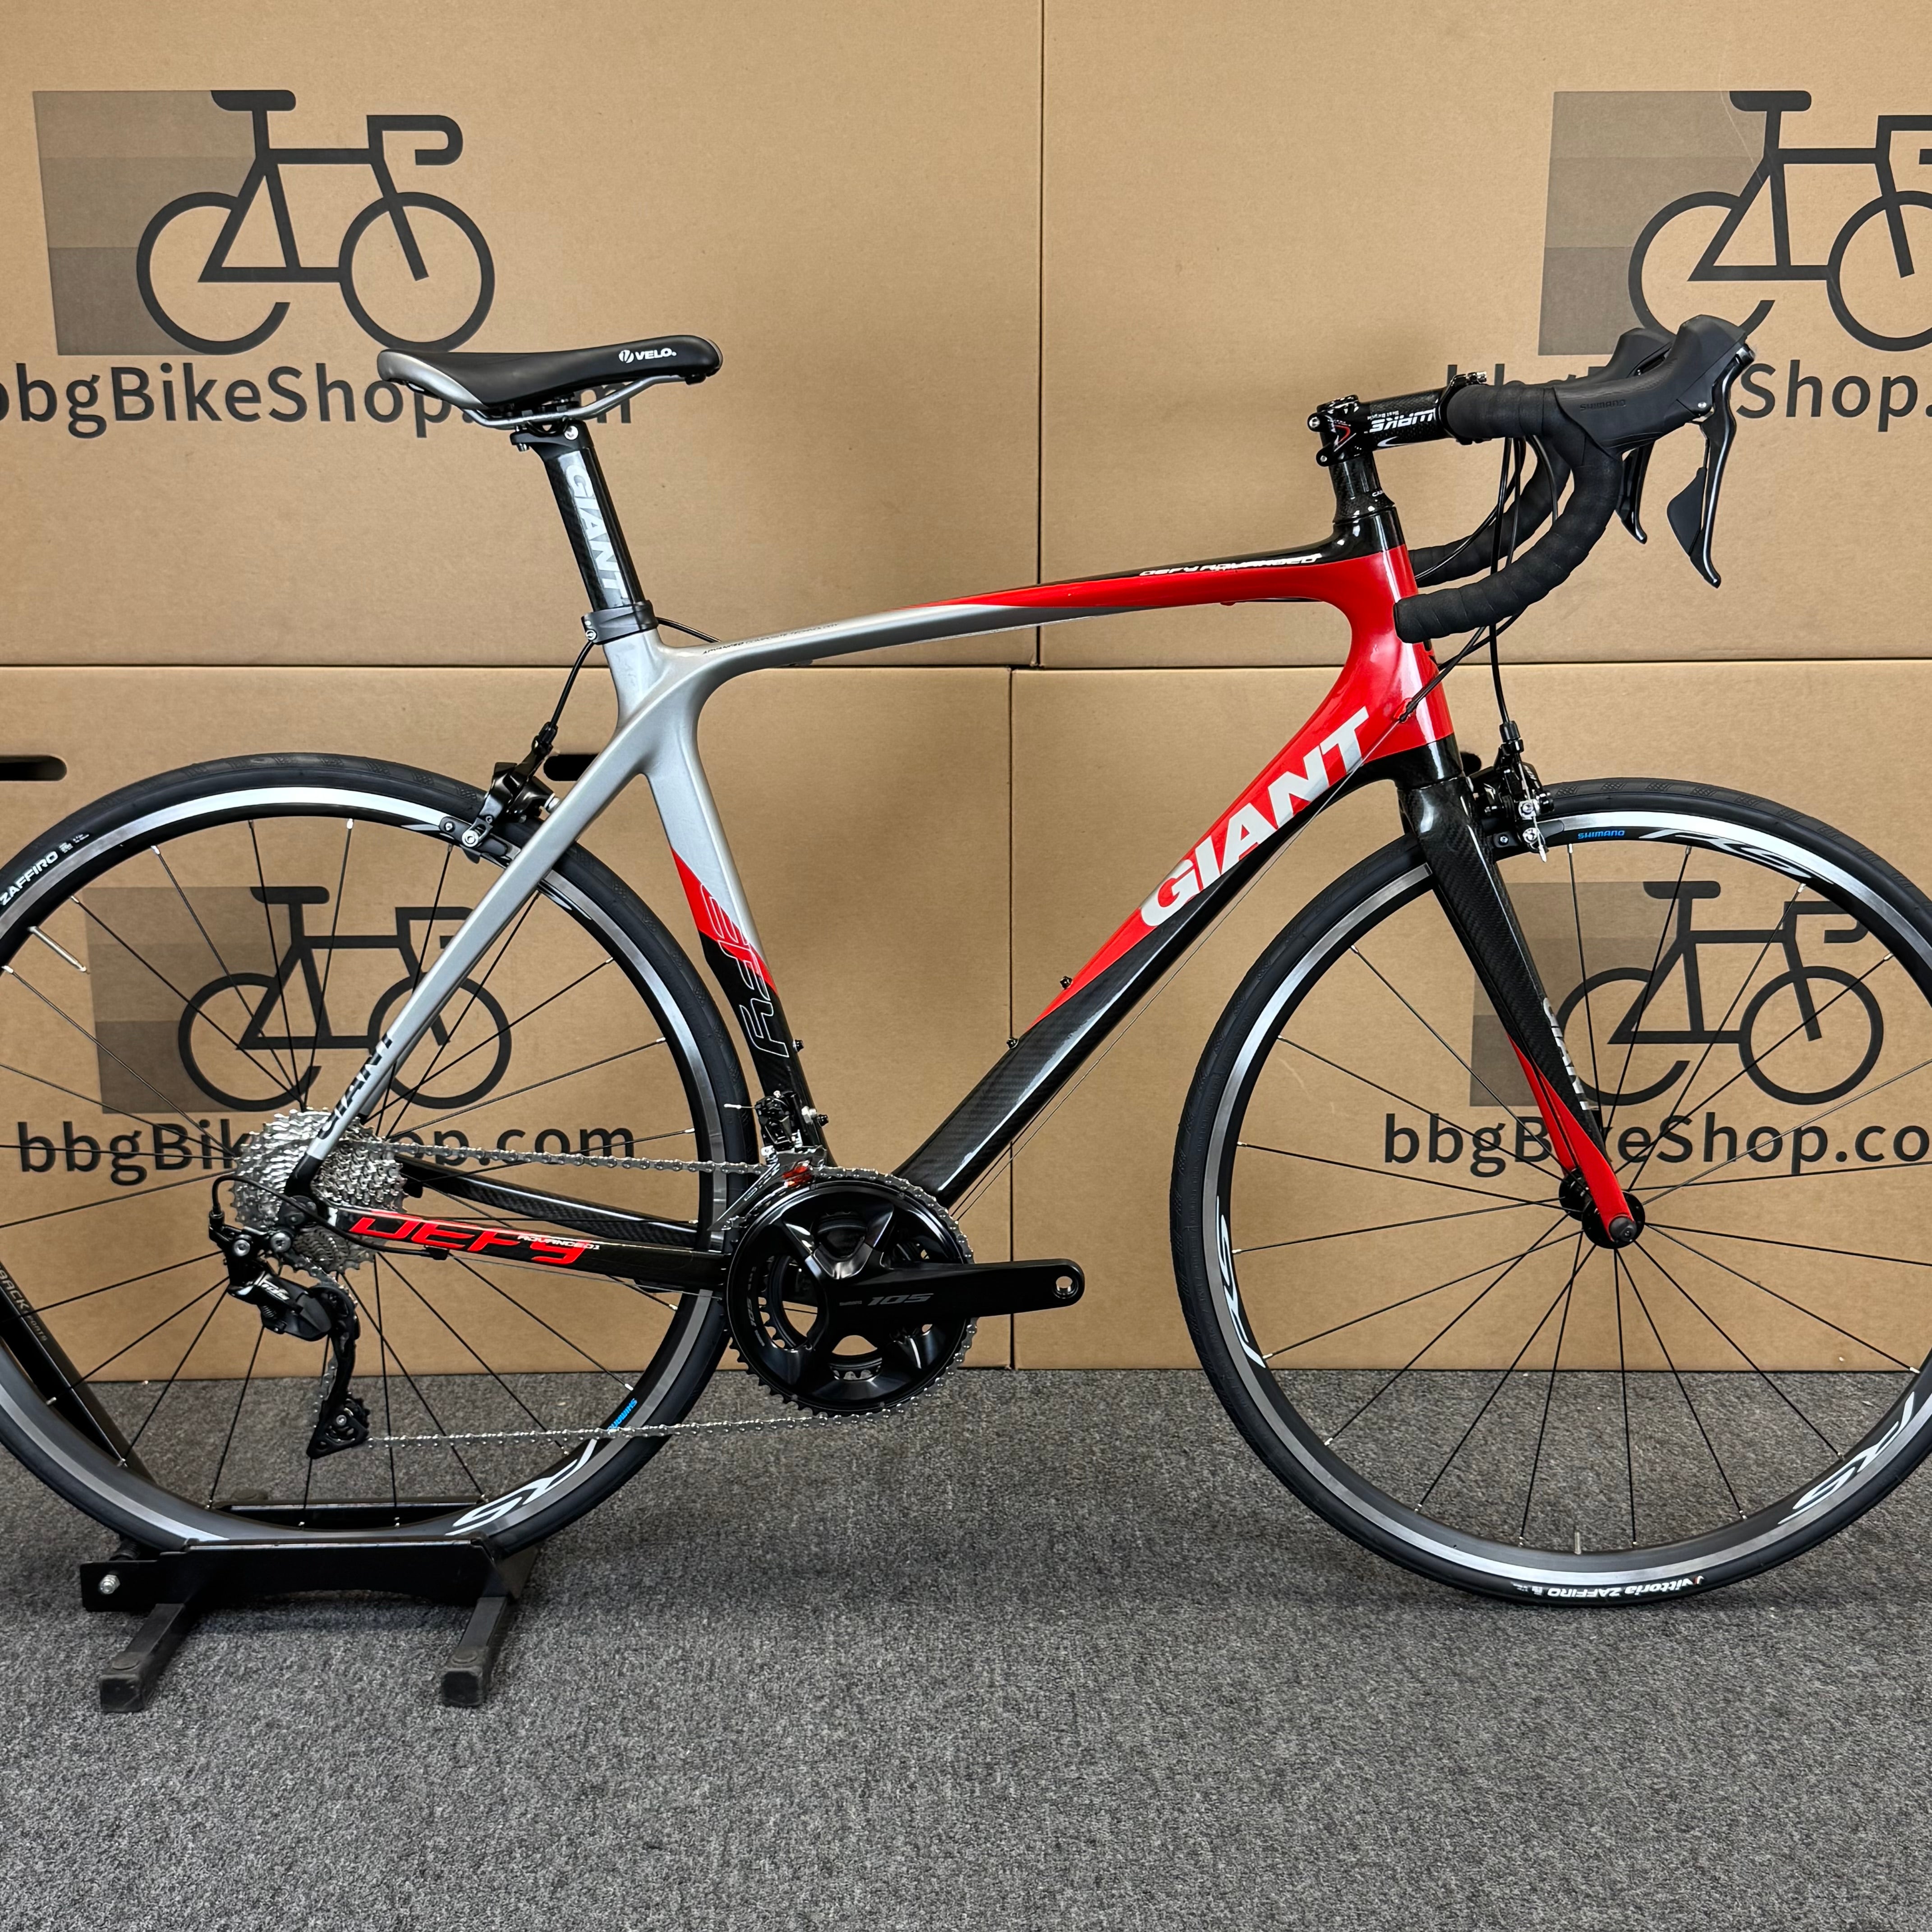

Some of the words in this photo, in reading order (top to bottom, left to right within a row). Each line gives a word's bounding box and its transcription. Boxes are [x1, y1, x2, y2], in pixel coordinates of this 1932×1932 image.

[565, 465, 629, 602] GIANT
[1139, 566, 1200, 576] DEFY
[1200, 553, 1323, 571] ADVANCED
[1141, 706, 1369, 926] GIANT
[1578, 830, 1625, 839] SHIMANO
[0, 851, 59, 905] ZAFFIRO
[1385, 1112, 1930, 1178] bbgBeShop.co
[349, 1210, 586, 1264] DEFY
[868, 1293, 934, 1306] 105
[1547, 1587, 1623, 1598] ZAFFIRO
[1624, 1578, 1694, 1596] vittoria
